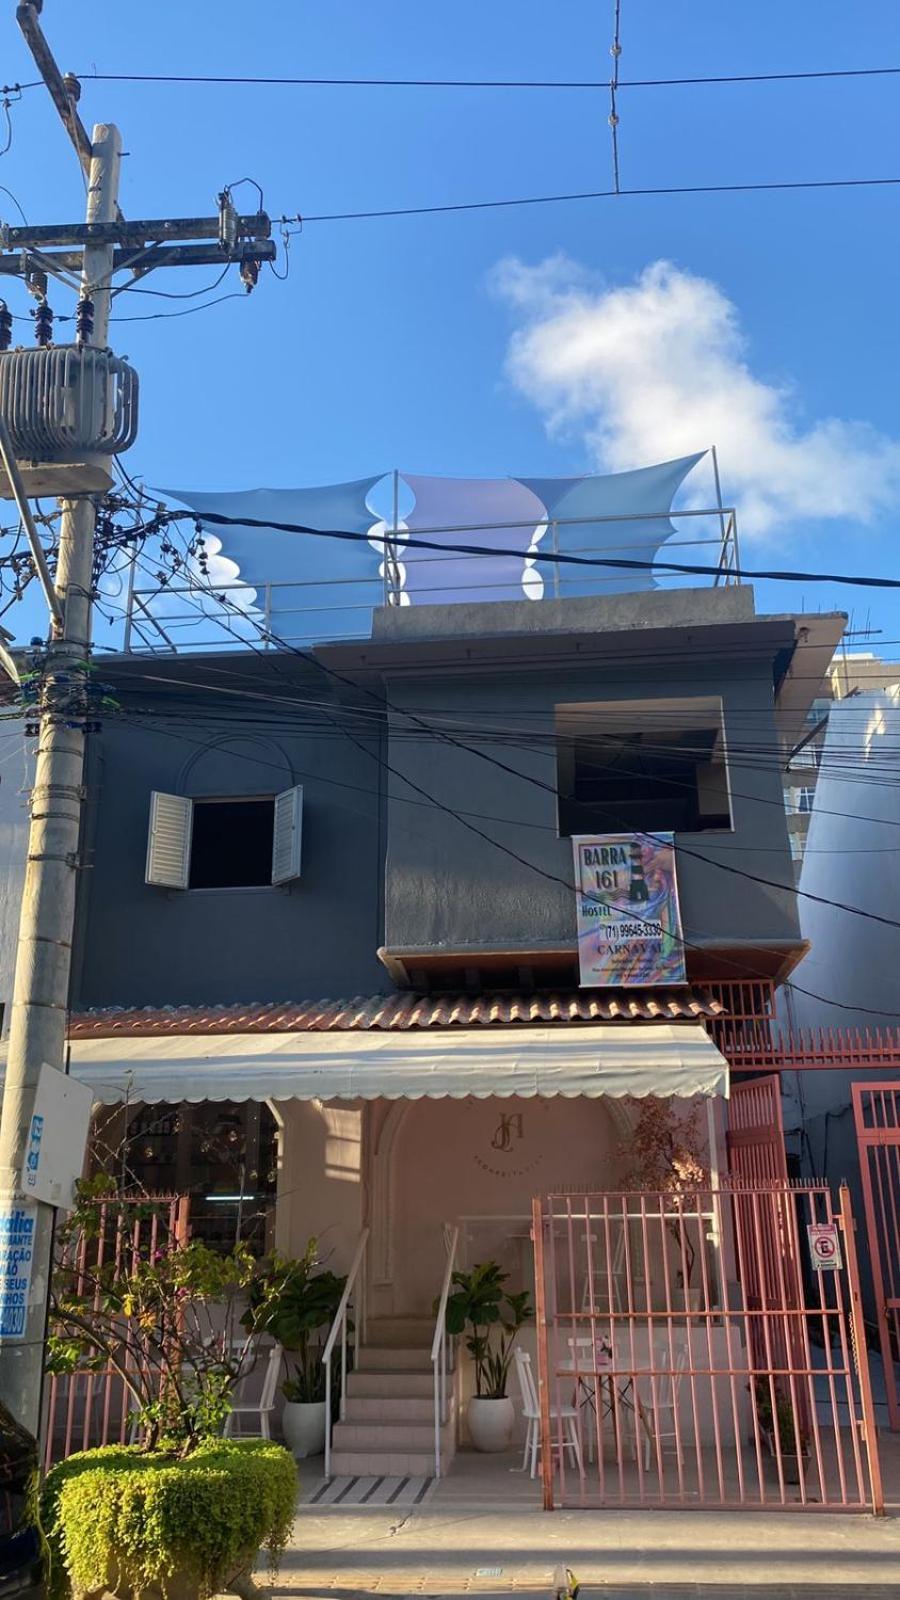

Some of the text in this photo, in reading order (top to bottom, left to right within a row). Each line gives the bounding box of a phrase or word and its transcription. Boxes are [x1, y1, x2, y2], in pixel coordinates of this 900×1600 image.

[584, 846, 627, 866] BARRA
[595, 870, 618, 889] 161
[605, 925, 619, 943] (71)
[597, 944, 662, 956] CARNAVAL
